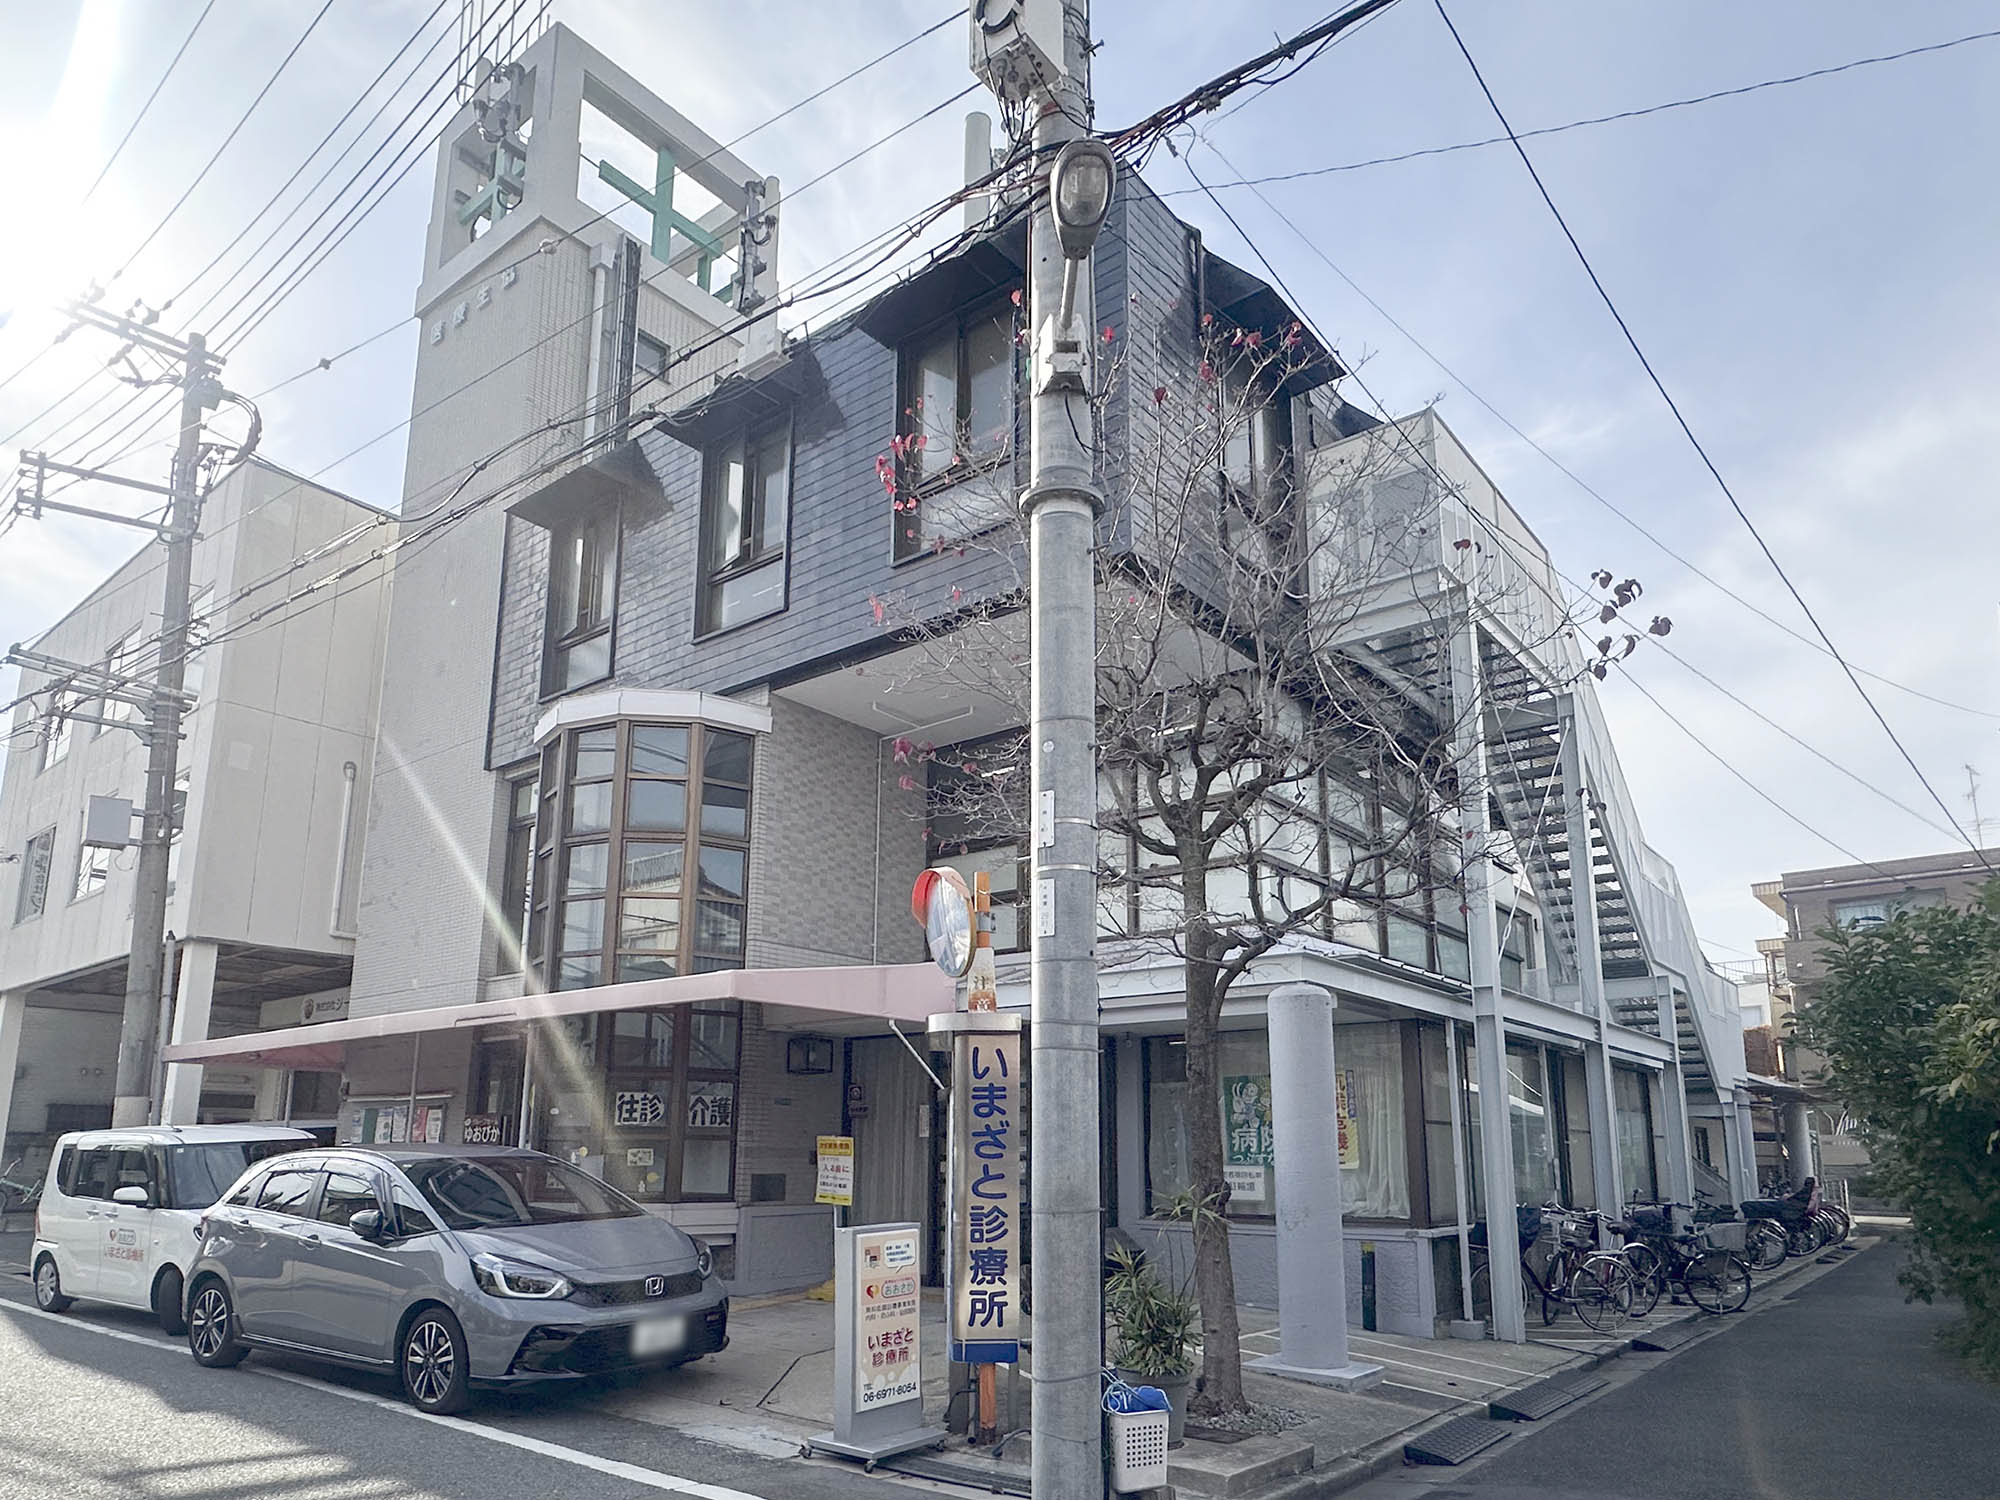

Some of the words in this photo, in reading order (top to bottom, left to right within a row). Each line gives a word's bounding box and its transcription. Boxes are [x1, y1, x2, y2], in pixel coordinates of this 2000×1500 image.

[617, 1093, 662, 1124] 往診
[689, 1096, 731, 1126] 介護
[464, 1125, 500, 1142] ゆおびか
[968, 1046, 1010, 1328] いまざと診療所
[868, 1328, 913, 1350] いまざと
[872, 1346, 909, 1368] 診療所
